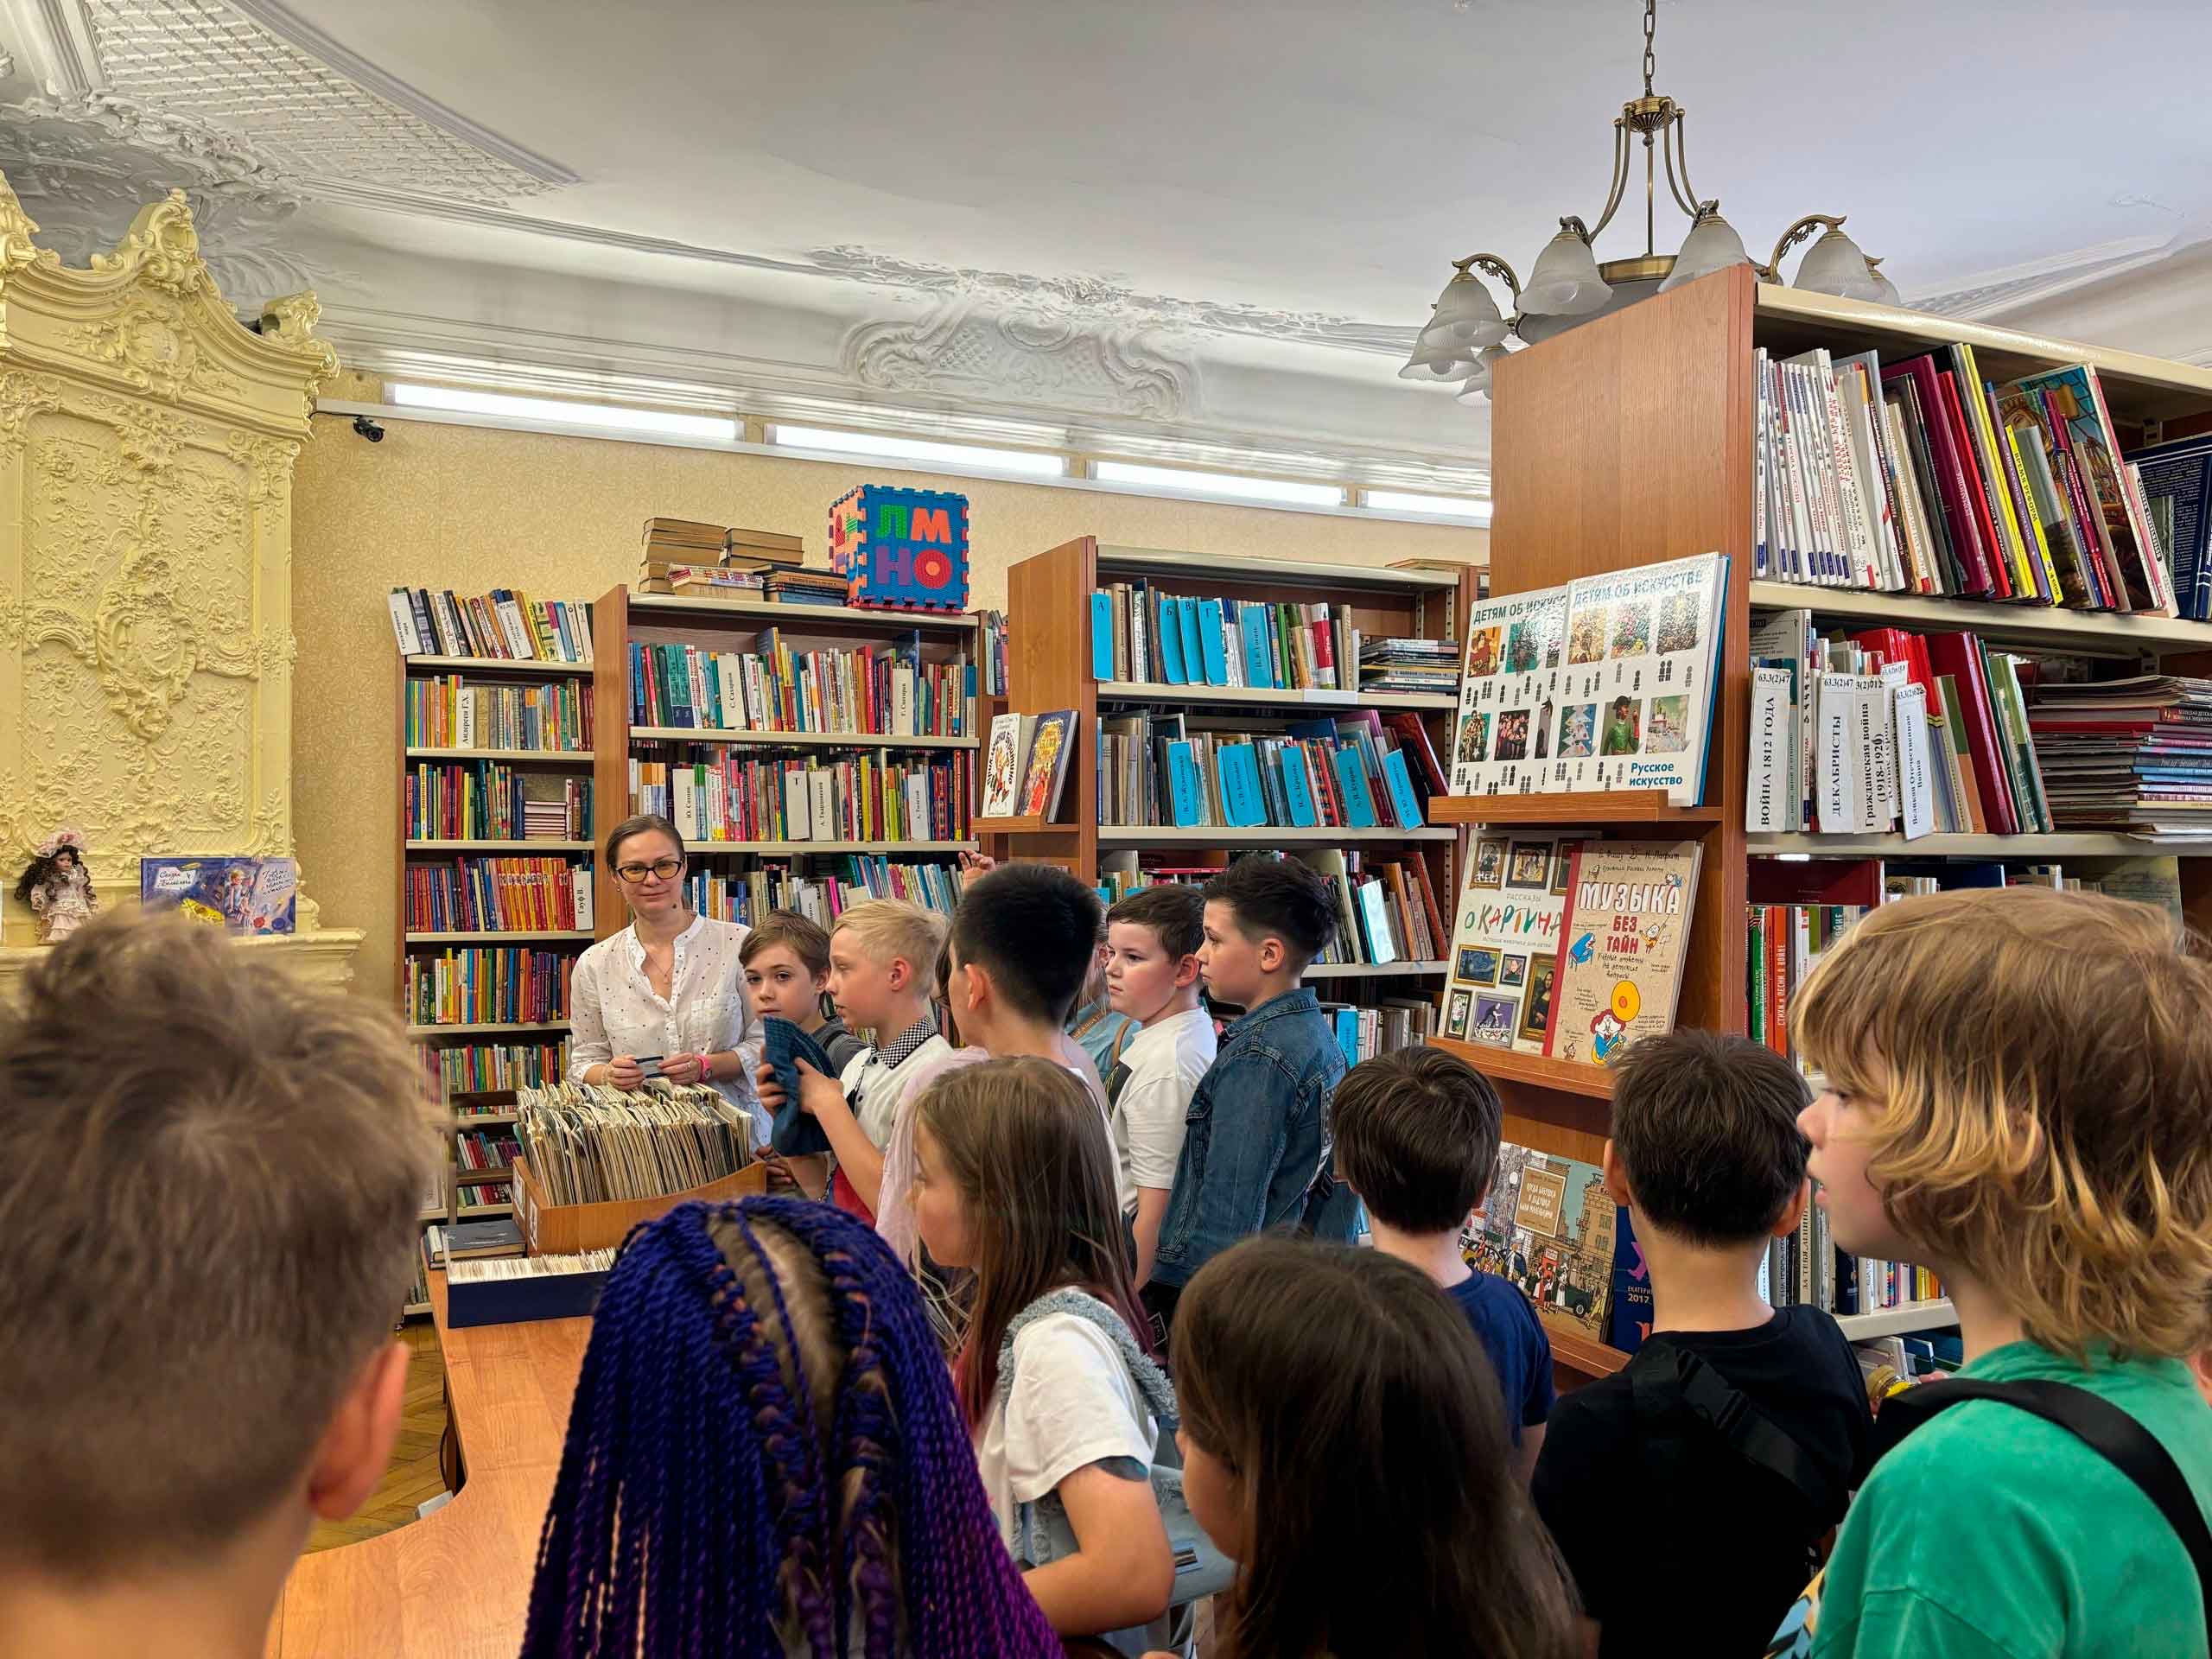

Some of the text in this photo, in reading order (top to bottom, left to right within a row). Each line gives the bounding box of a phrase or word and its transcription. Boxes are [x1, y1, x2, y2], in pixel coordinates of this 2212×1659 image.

[1614, 582, 1631, 598] ОБ
[1634, 569, 1703, 594] ИСКУССТВЕ
[1473, 594, 1567, 624] ДЕТЯМ ОБ ИСКУСС
[1758, 674, 1790, 685] 63.3(2)47
[1824, 677, 1853, 688] 63.3(2)47
[1905, 715, 1916, 785] Отечественная
[1630, 760, 1675, 776] Русское
[1761, 697, 1775, 825] ВОЙНА 1812 ГОДА
[1832, 715, 1841, 816] ДЕКАБРИСТЫ
[1860, 703, 1875, 827] Гражданская война
[1629, 774, 1684, 789] искусство
[1506, 893, 1541, 902] РАССКАЗЫ
[1578, 881, 1681, 914] МУЗЫКА
[1478, 904, 1562, 937] КАРТИНА
[1613, 915, 1638, 933] БЕЗ
[1606, 935, 1639, 954] ТАЙН
[1777, 976, 1786, 996] ПЕСНИ
[1777, 1007, 1786, 1026] СТИХИ
[1628, 1286, 1654, 1295] ЕКАТЕРИ
[1628, 1294, 1650, 1304] 2017
